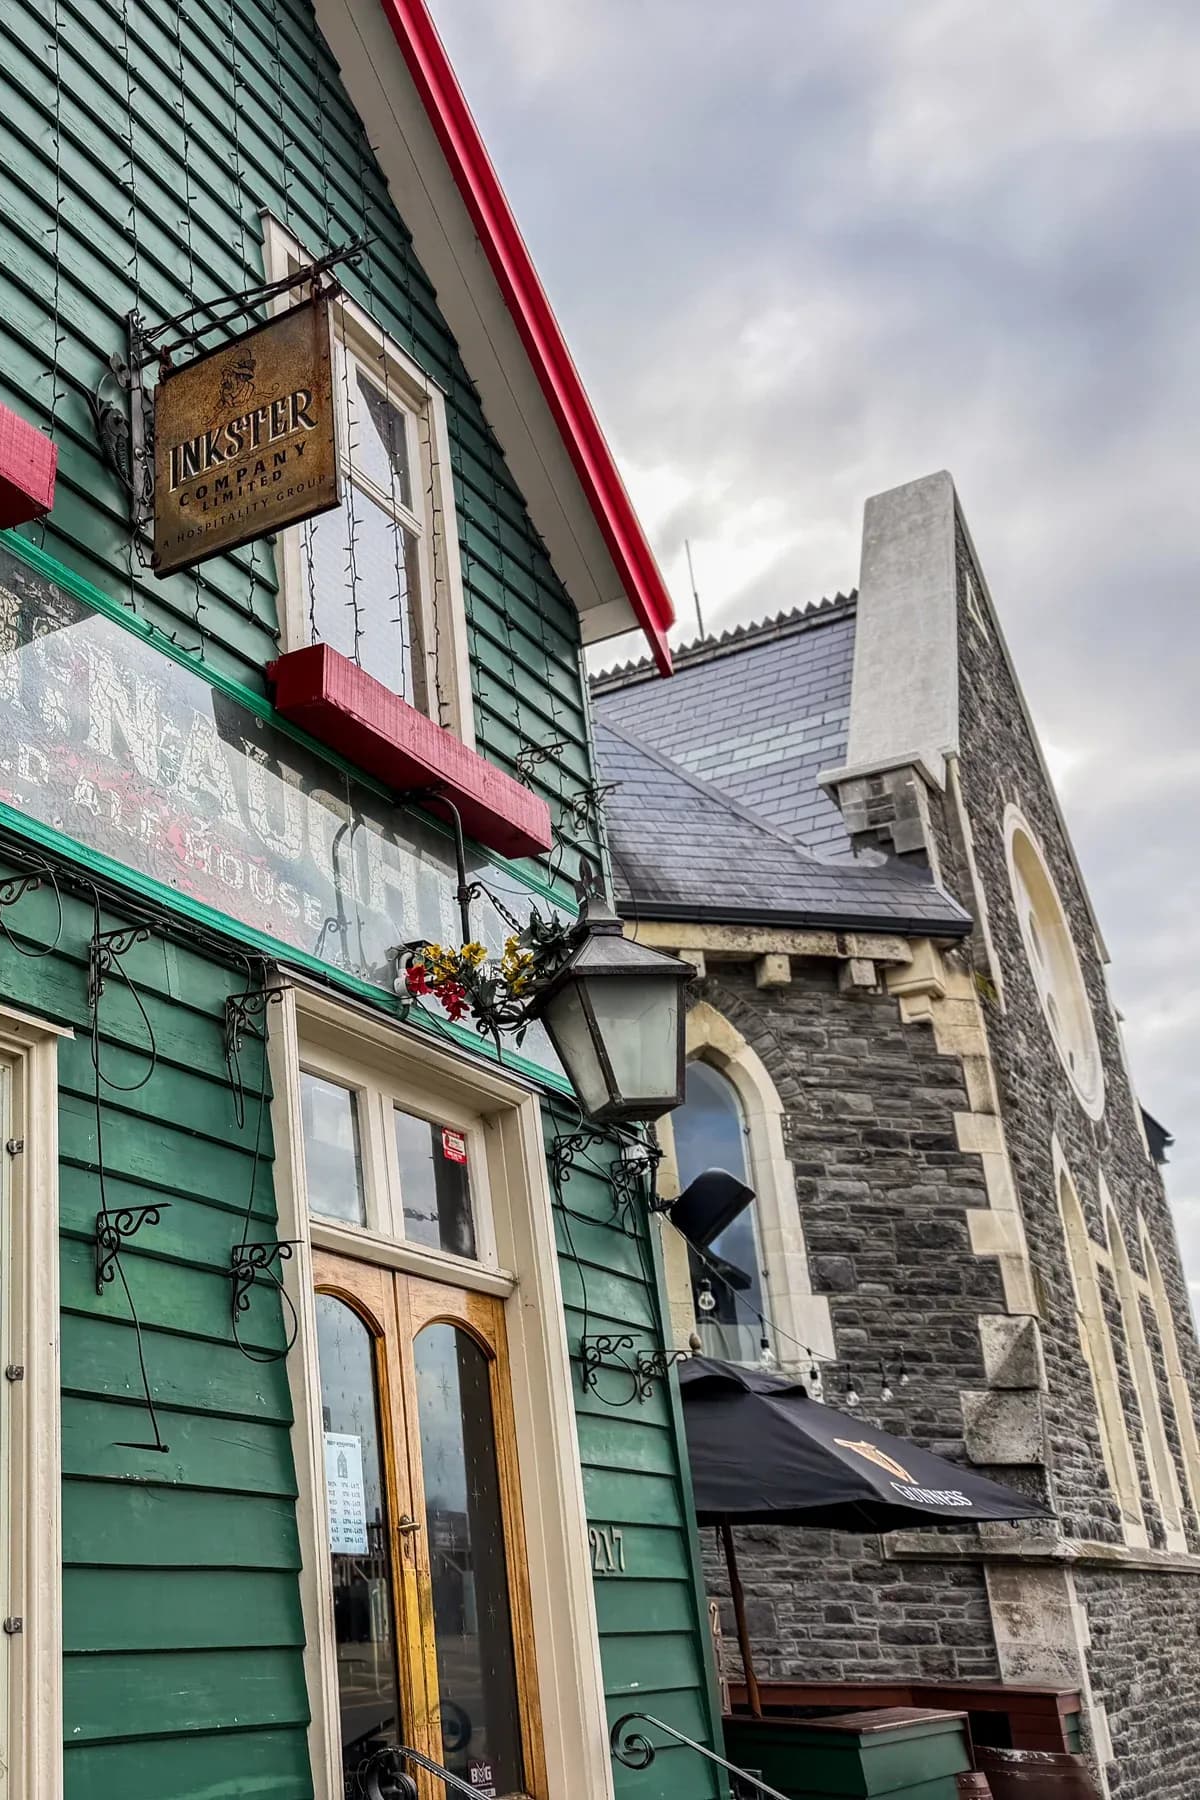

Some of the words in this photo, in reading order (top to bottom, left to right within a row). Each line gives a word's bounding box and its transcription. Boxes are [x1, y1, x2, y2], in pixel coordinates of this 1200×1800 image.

[169, 388, 318, 493] INKSTER
[179, 441, 306, 507] COMPANY
[202, 470, 282, 512] LIMITED
[162, 540, 170, 549] A
[177, 499, 268, 544] HOSPITALITY
[276, 474, 326, 500] GROUP
[184, 828, 324, 930] HOUSE
[889, 1481, 973, 1506] GUINNESS
[588, 1525, 625, 1573] 217
